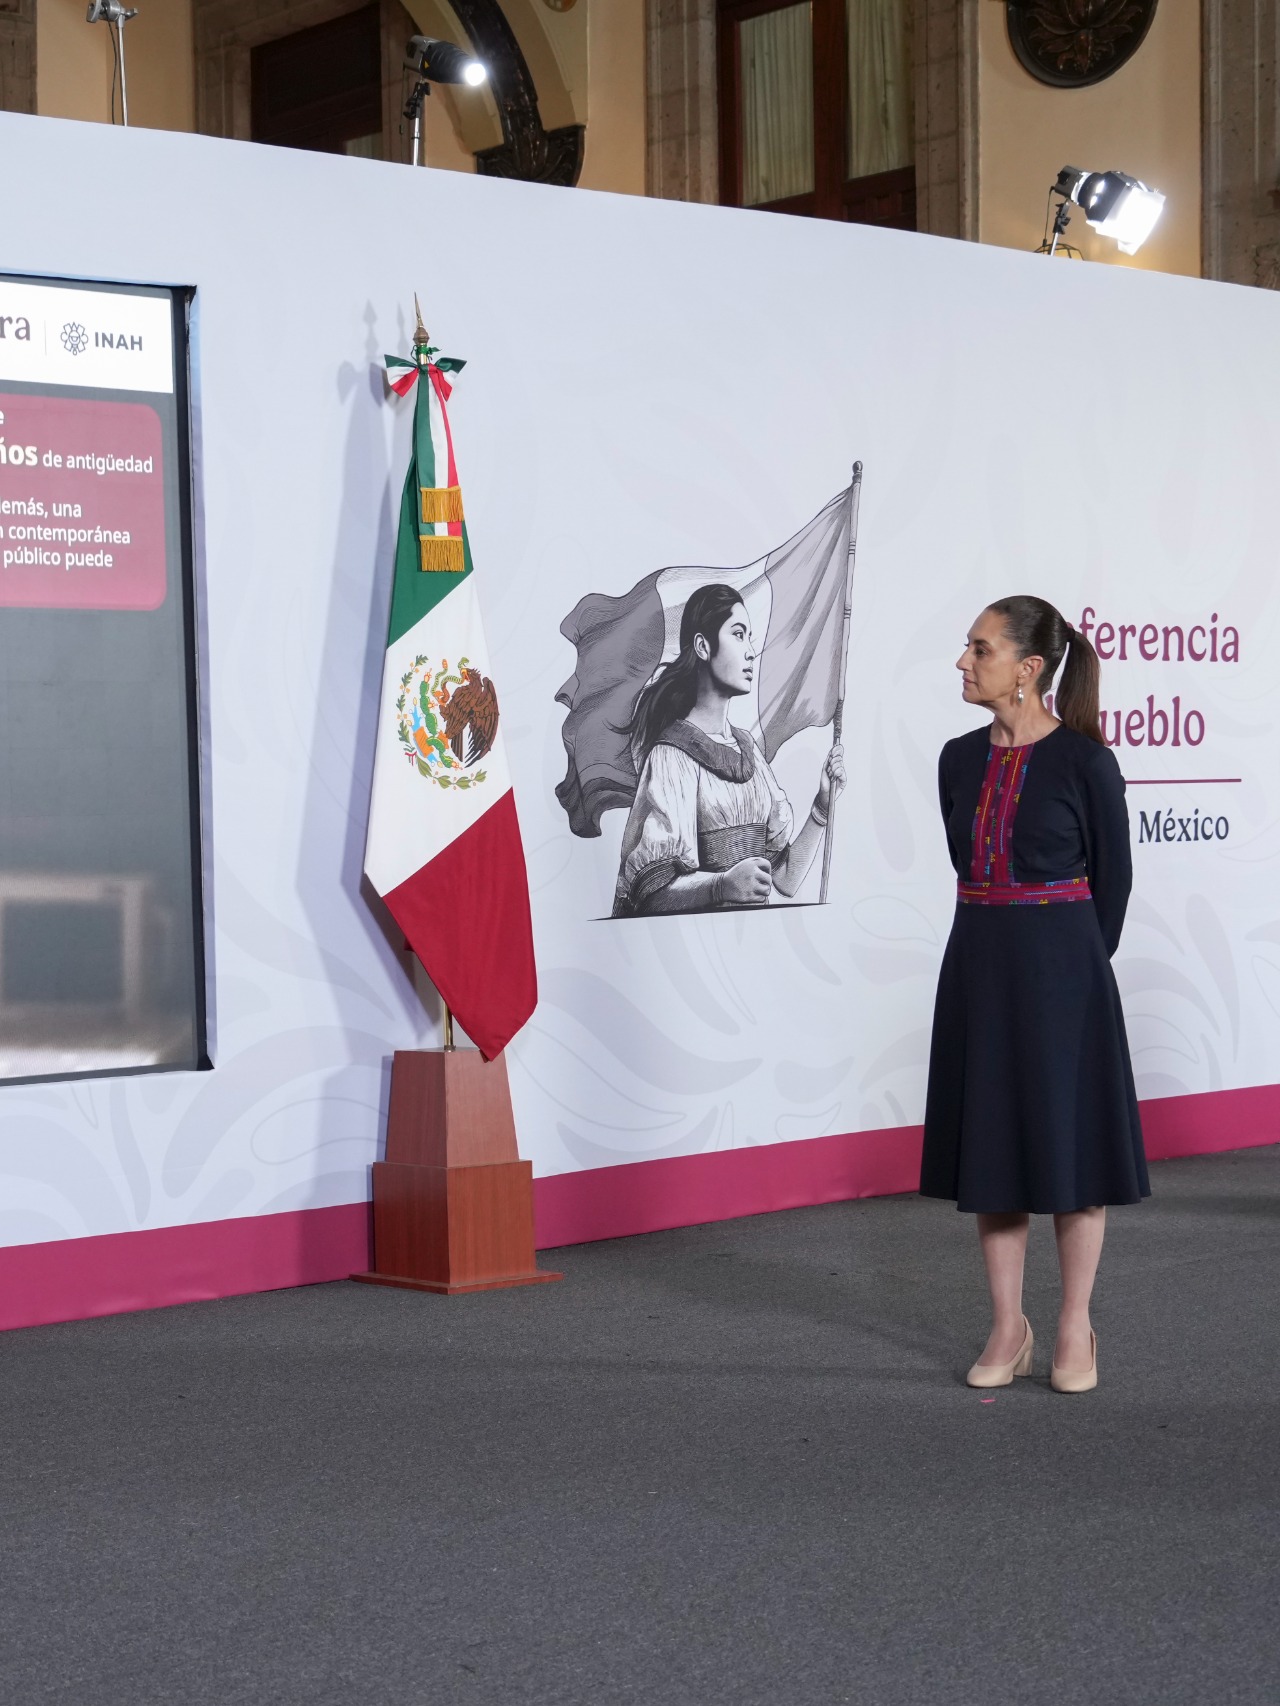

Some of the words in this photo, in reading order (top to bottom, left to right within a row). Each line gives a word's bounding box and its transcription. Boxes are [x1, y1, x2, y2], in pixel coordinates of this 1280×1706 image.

[94, 331, 143, 352] INAH
[43, 449, 62, 468] de
[66, 452, 153, 475] antigüedad
[53, 501, 82, 518] una
[8, 525, 131, 547] contemporánea
[4, 545, 61, 568] público
[65, 549, 113, 570] puede
[1066, 607, 1240, 663] ferencia
[1099, 694, 1205, 747] ueblo
[1138, 808, 1230, 843] México
